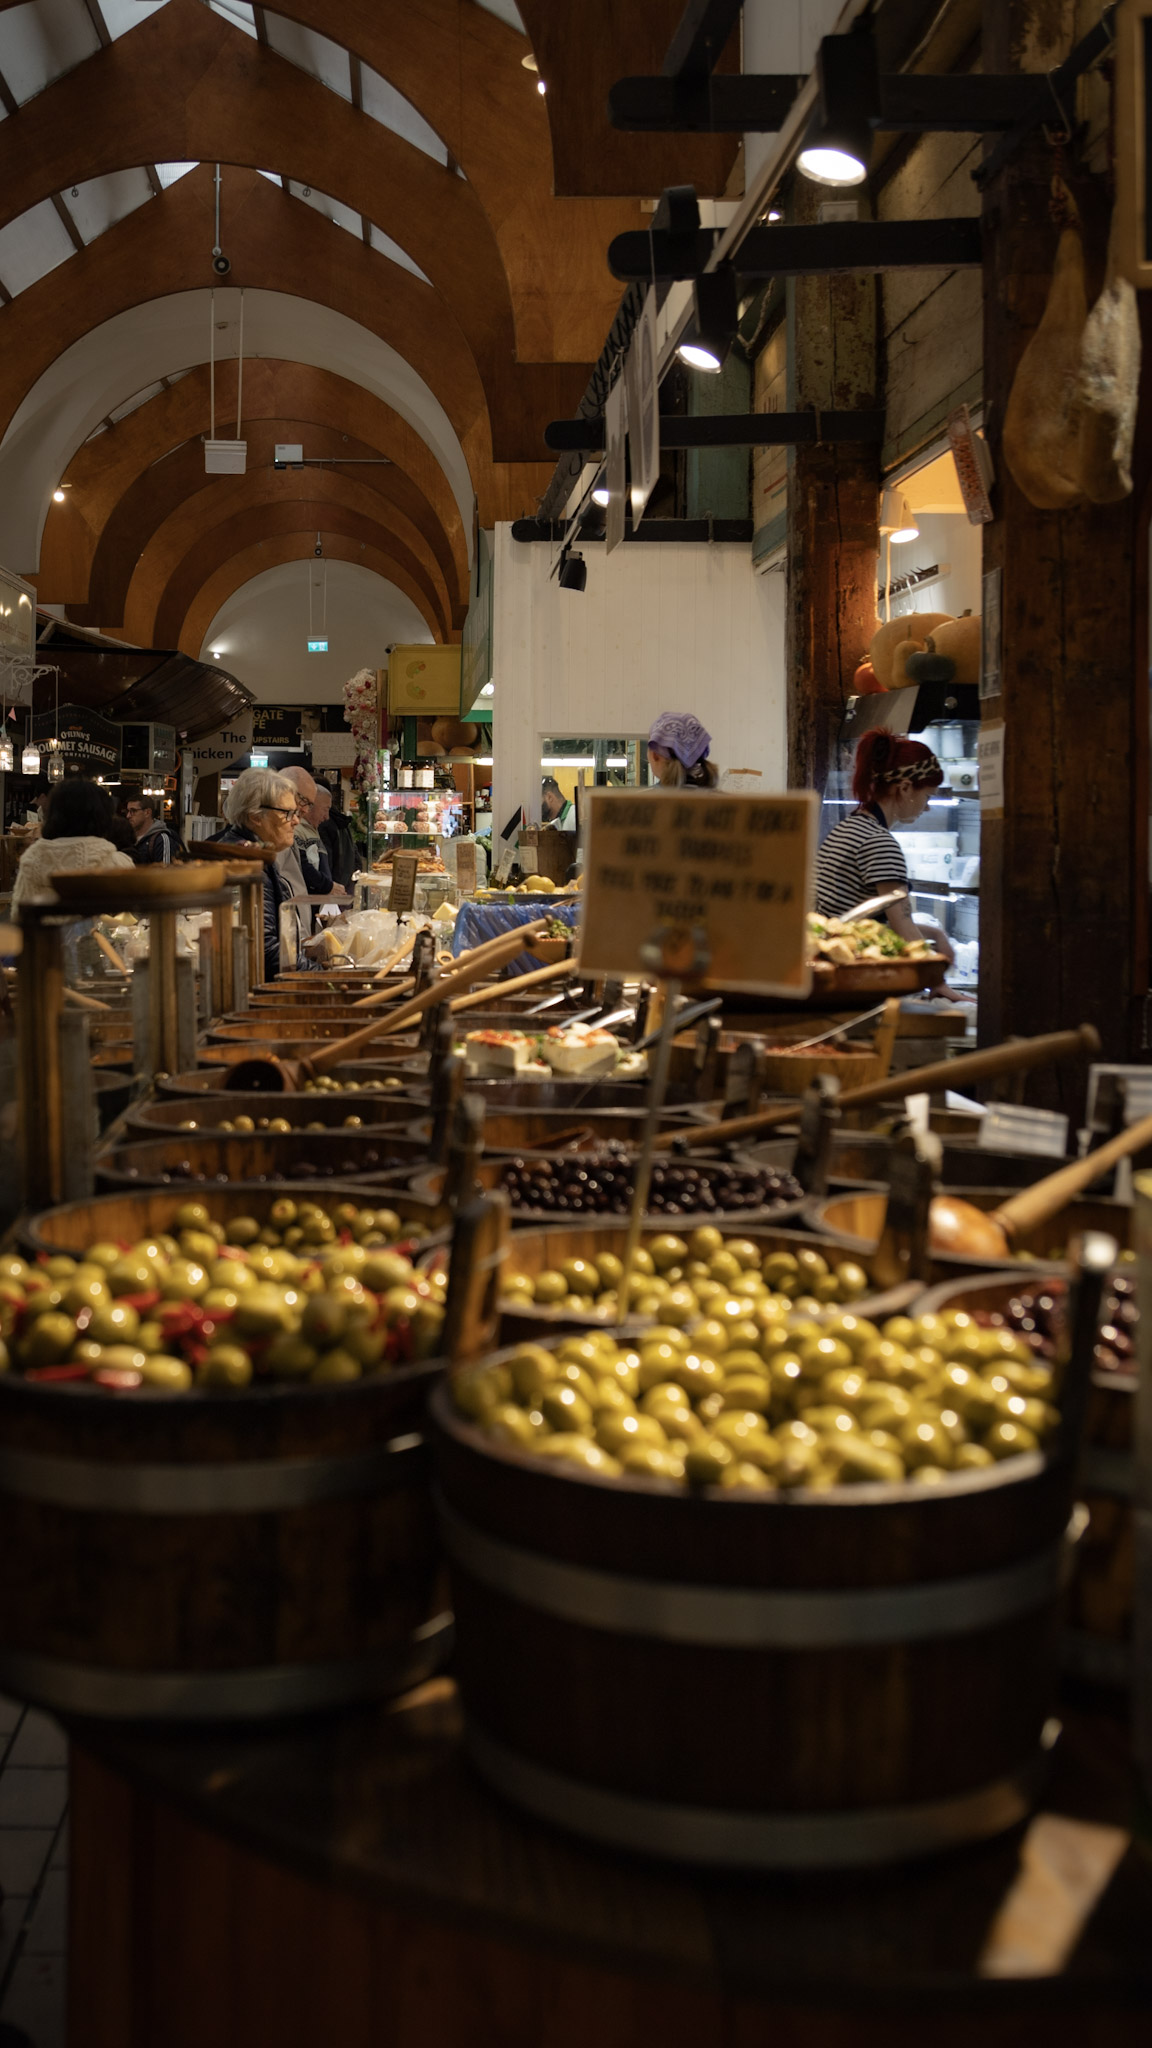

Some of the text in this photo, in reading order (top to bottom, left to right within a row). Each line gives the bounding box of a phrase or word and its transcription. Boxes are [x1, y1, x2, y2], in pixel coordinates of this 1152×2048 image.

[220, 732, 247, 743] The
[36, 741, 117, 763] OUMET SAUSAGE
